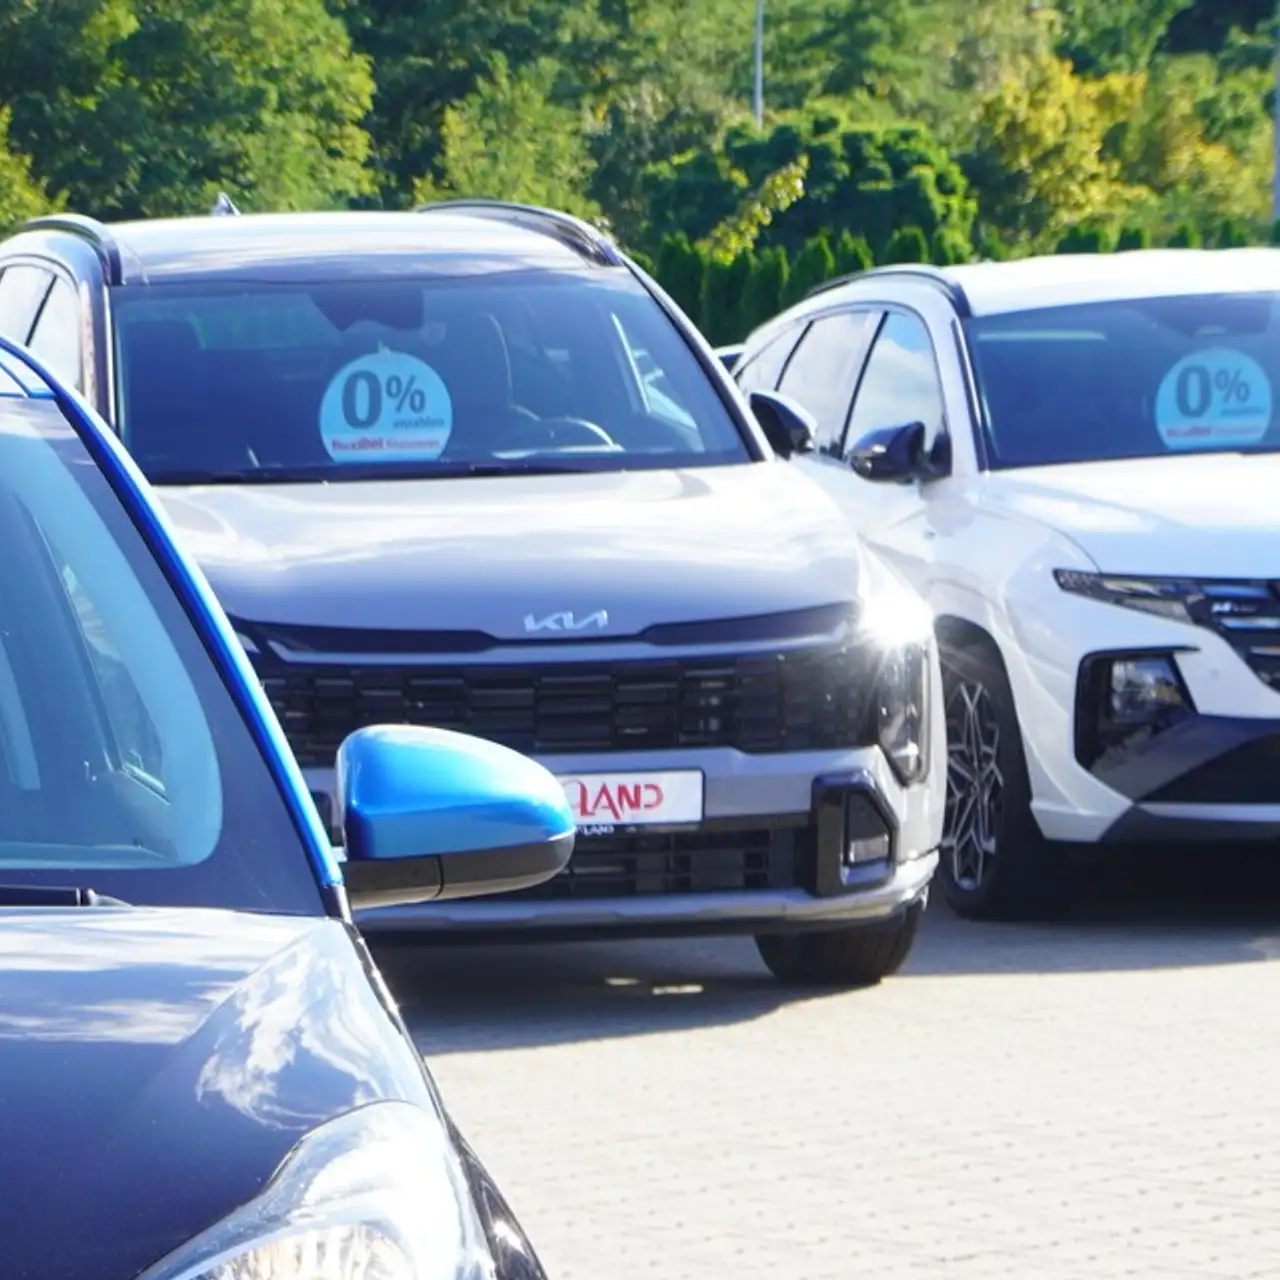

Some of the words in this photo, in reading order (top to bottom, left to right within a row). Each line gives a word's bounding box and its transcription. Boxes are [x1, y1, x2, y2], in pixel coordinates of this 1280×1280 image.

[342, 369, 426, 430] 0%
[1176, 365, 1251, 418] 0%
[523, 608, 609, 634] KIA
